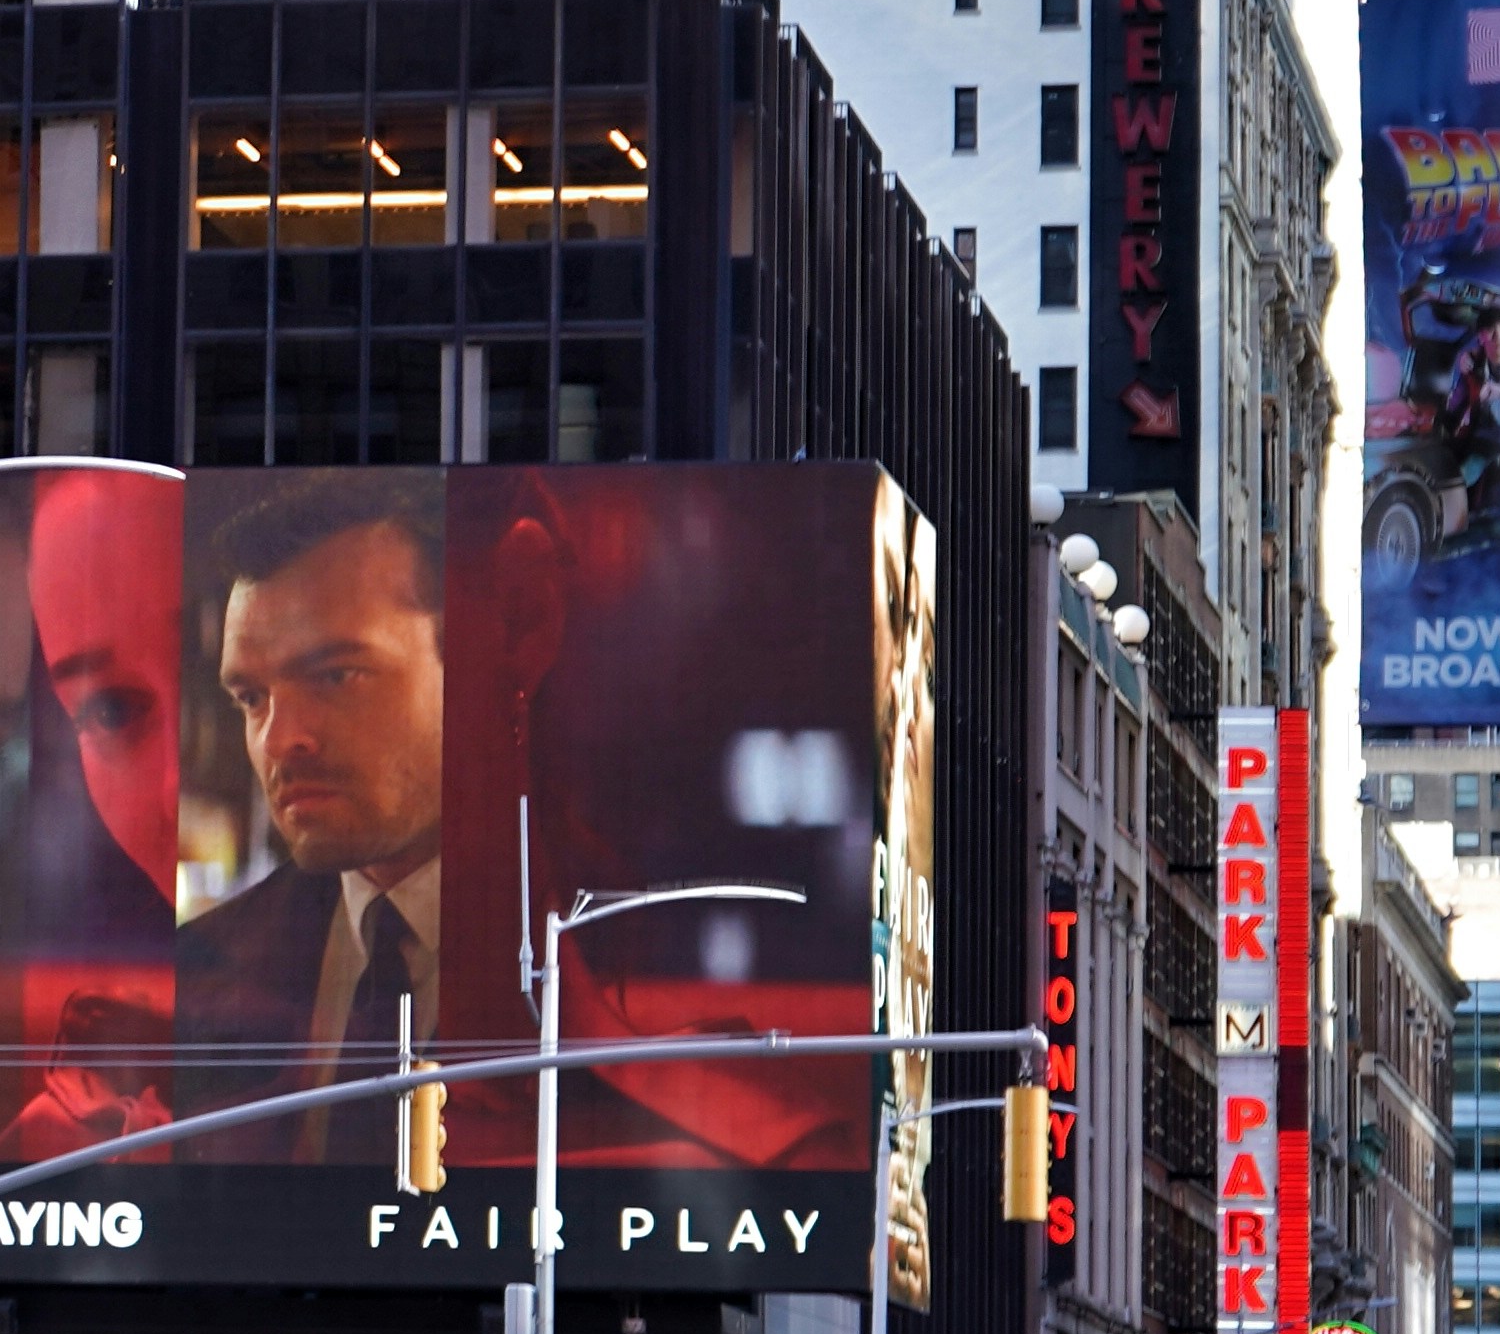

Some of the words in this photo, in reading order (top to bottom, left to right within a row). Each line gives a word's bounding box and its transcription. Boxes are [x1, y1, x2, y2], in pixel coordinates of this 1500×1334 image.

[1409, 187, 1457, 217] TO
[1223, 747, 1268, 962] PARK
[620, 1206, 821, 1254] PLAY
[1222, 1097, 1268, 1314] PARK
